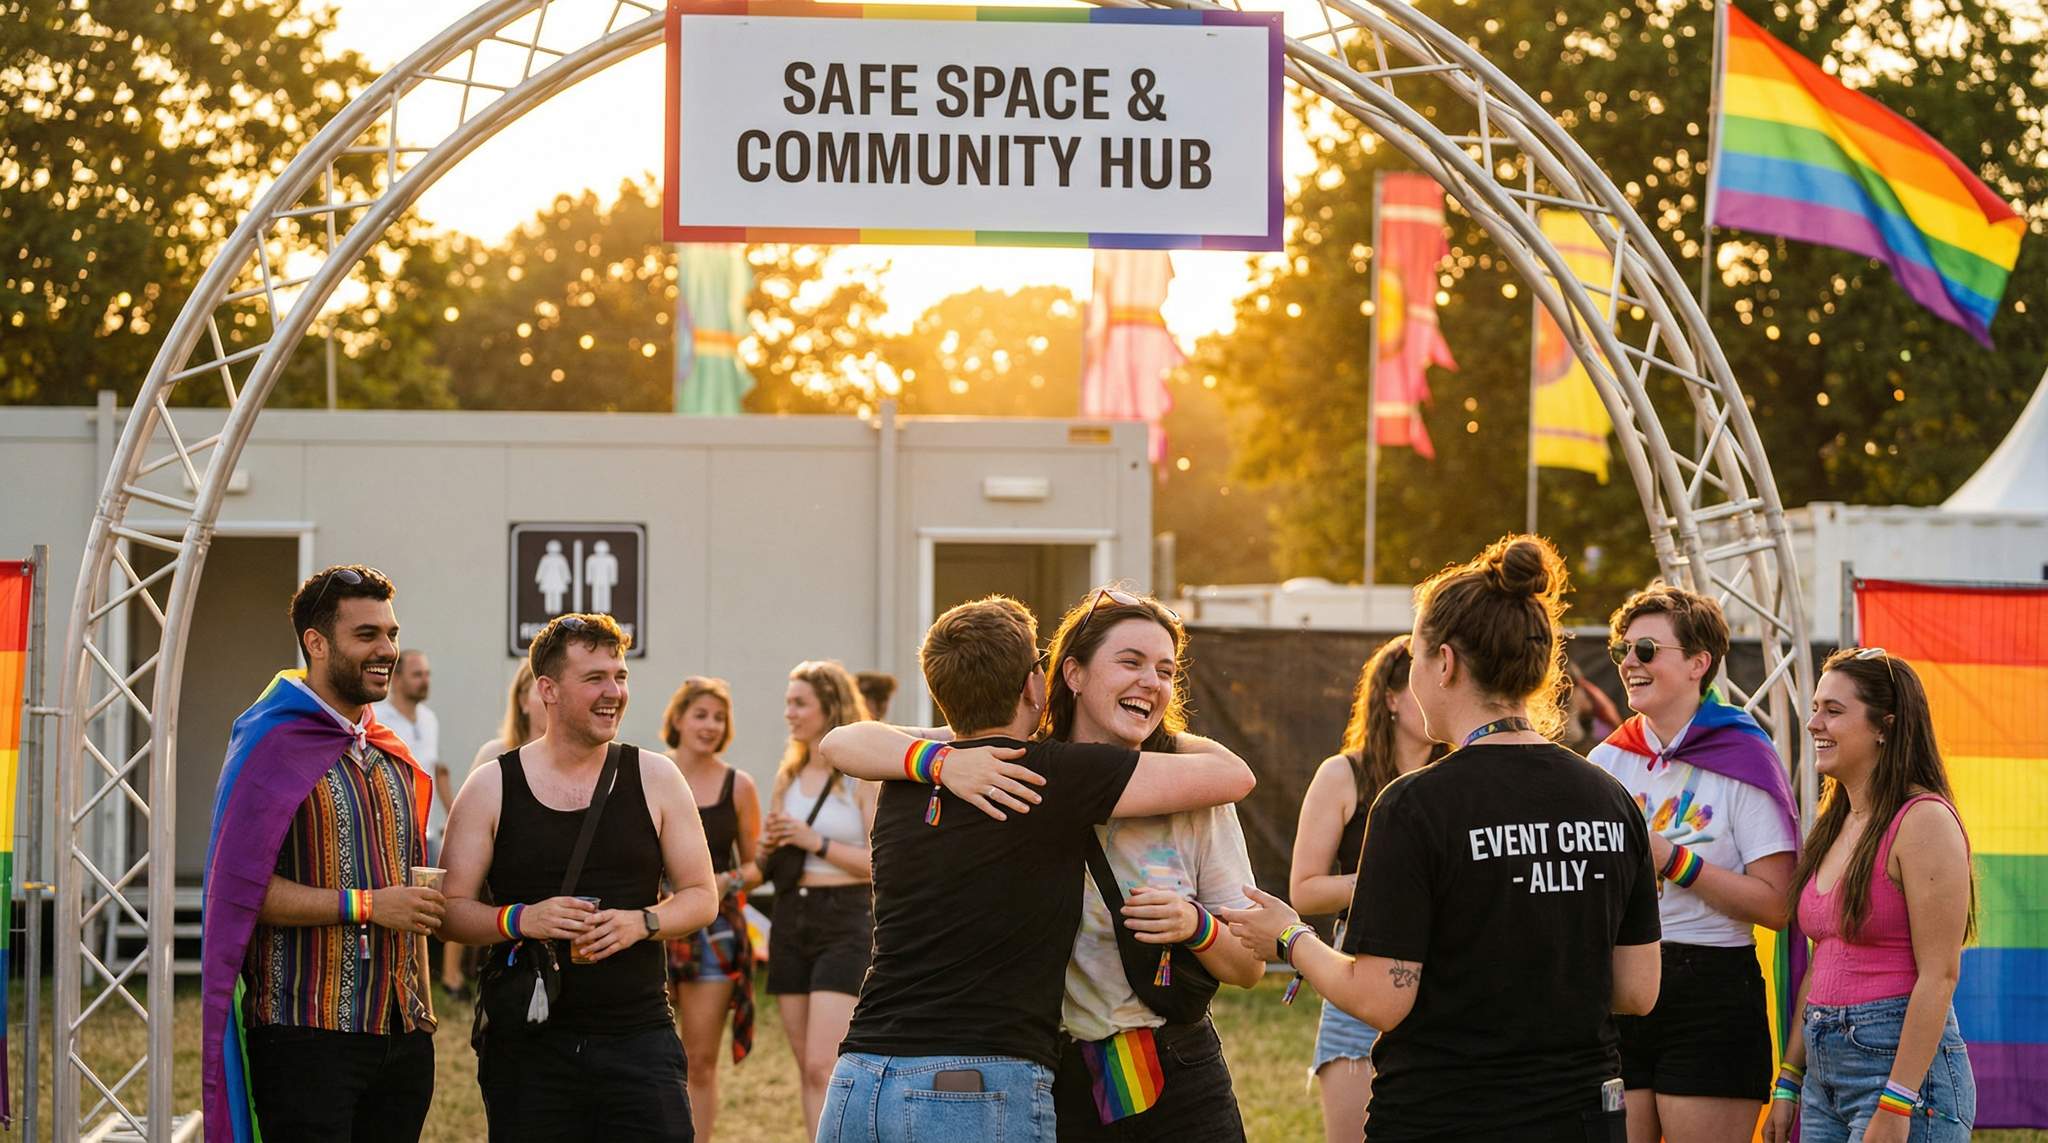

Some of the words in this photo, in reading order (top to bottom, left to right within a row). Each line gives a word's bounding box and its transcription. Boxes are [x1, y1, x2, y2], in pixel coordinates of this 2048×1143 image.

[783, 61, 918, 117] SAFE
[936, 64, 1110, 121] SPACE
[1127, 67, 1167, 122] &
[737, 129, 1082, 188] COMMUNITY
[1100, 136, 1212, 190] HUB
[1469, 822, 1550, 861] EVENT
[1557, 820, 1625, 853] CREW
[1529, 859, 1588, 894] ALLY
